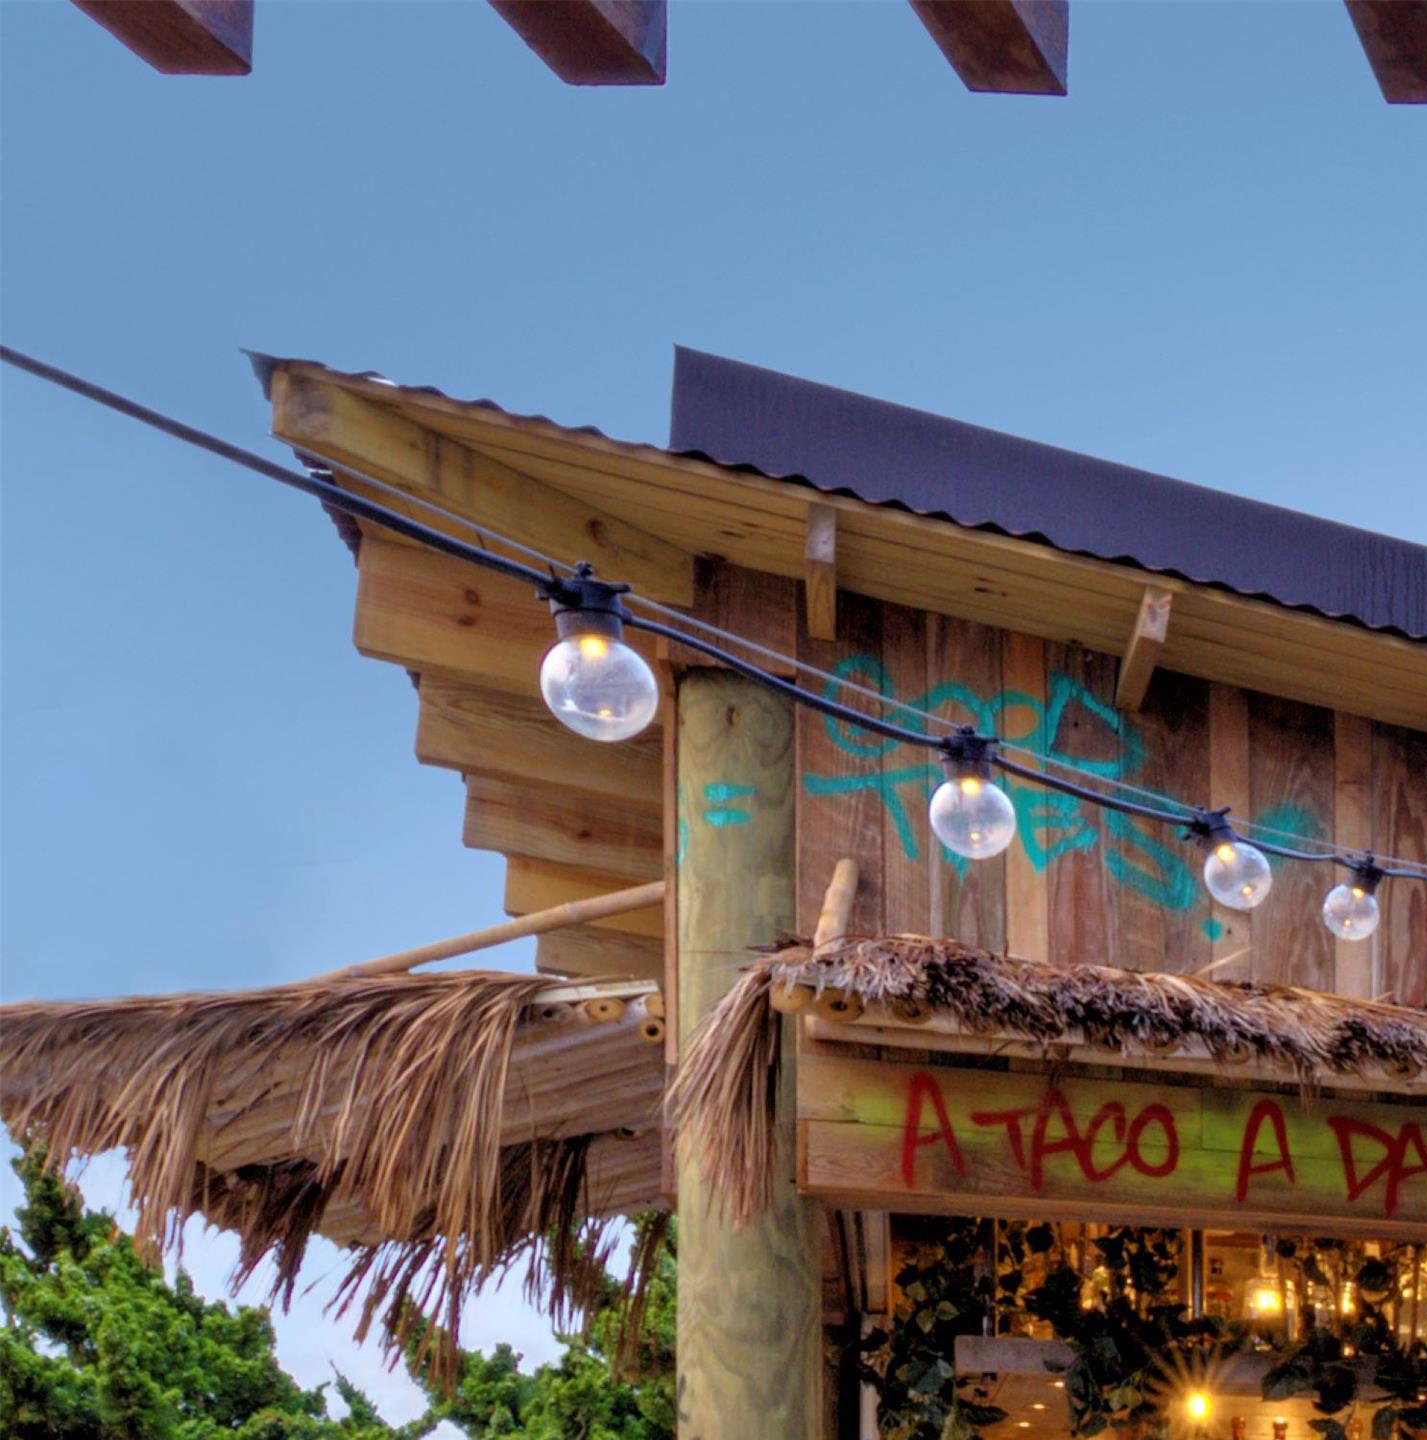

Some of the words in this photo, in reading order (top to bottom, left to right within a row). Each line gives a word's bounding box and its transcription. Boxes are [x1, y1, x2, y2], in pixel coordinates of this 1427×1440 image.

[900, 1072, 966, 1188] A
[970, 1083, 1180, 1190] TACO
[1235, 1098, 1296, 1203] A
